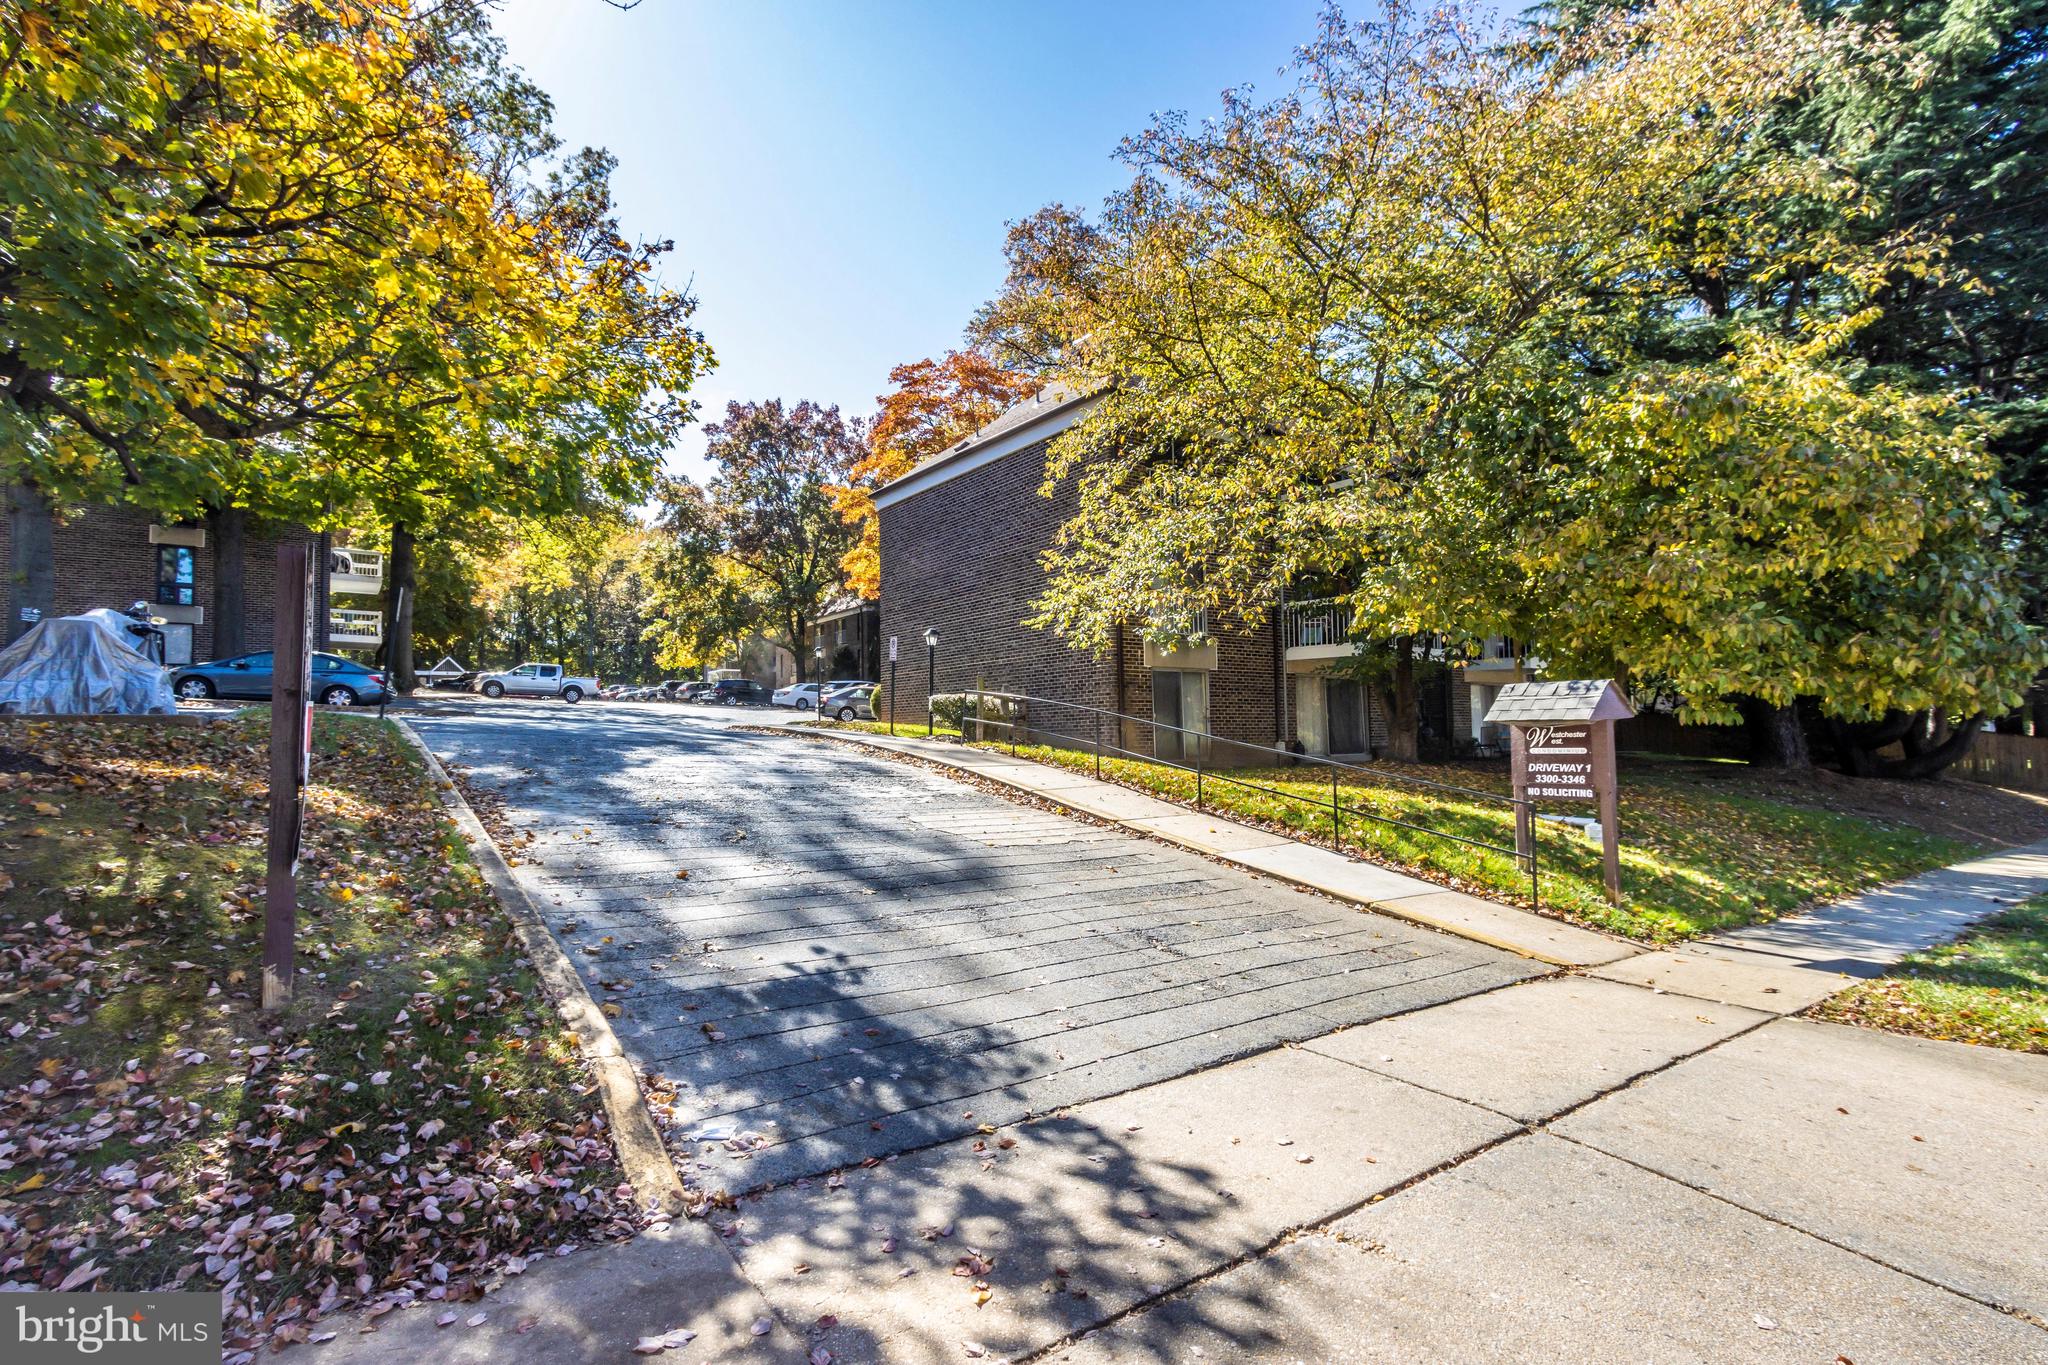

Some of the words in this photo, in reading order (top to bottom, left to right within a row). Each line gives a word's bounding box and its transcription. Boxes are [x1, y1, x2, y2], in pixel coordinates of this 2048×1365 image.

[1527, 726, 1586, 747] Westchester
[1528, 764, 1583, 772] DRIVEWAY
[1585, 764, 1591, 772] 1
[1535, 775, 1585, 783] 3300-3346
[1542, 788, 1593, 797] SOLICITING
